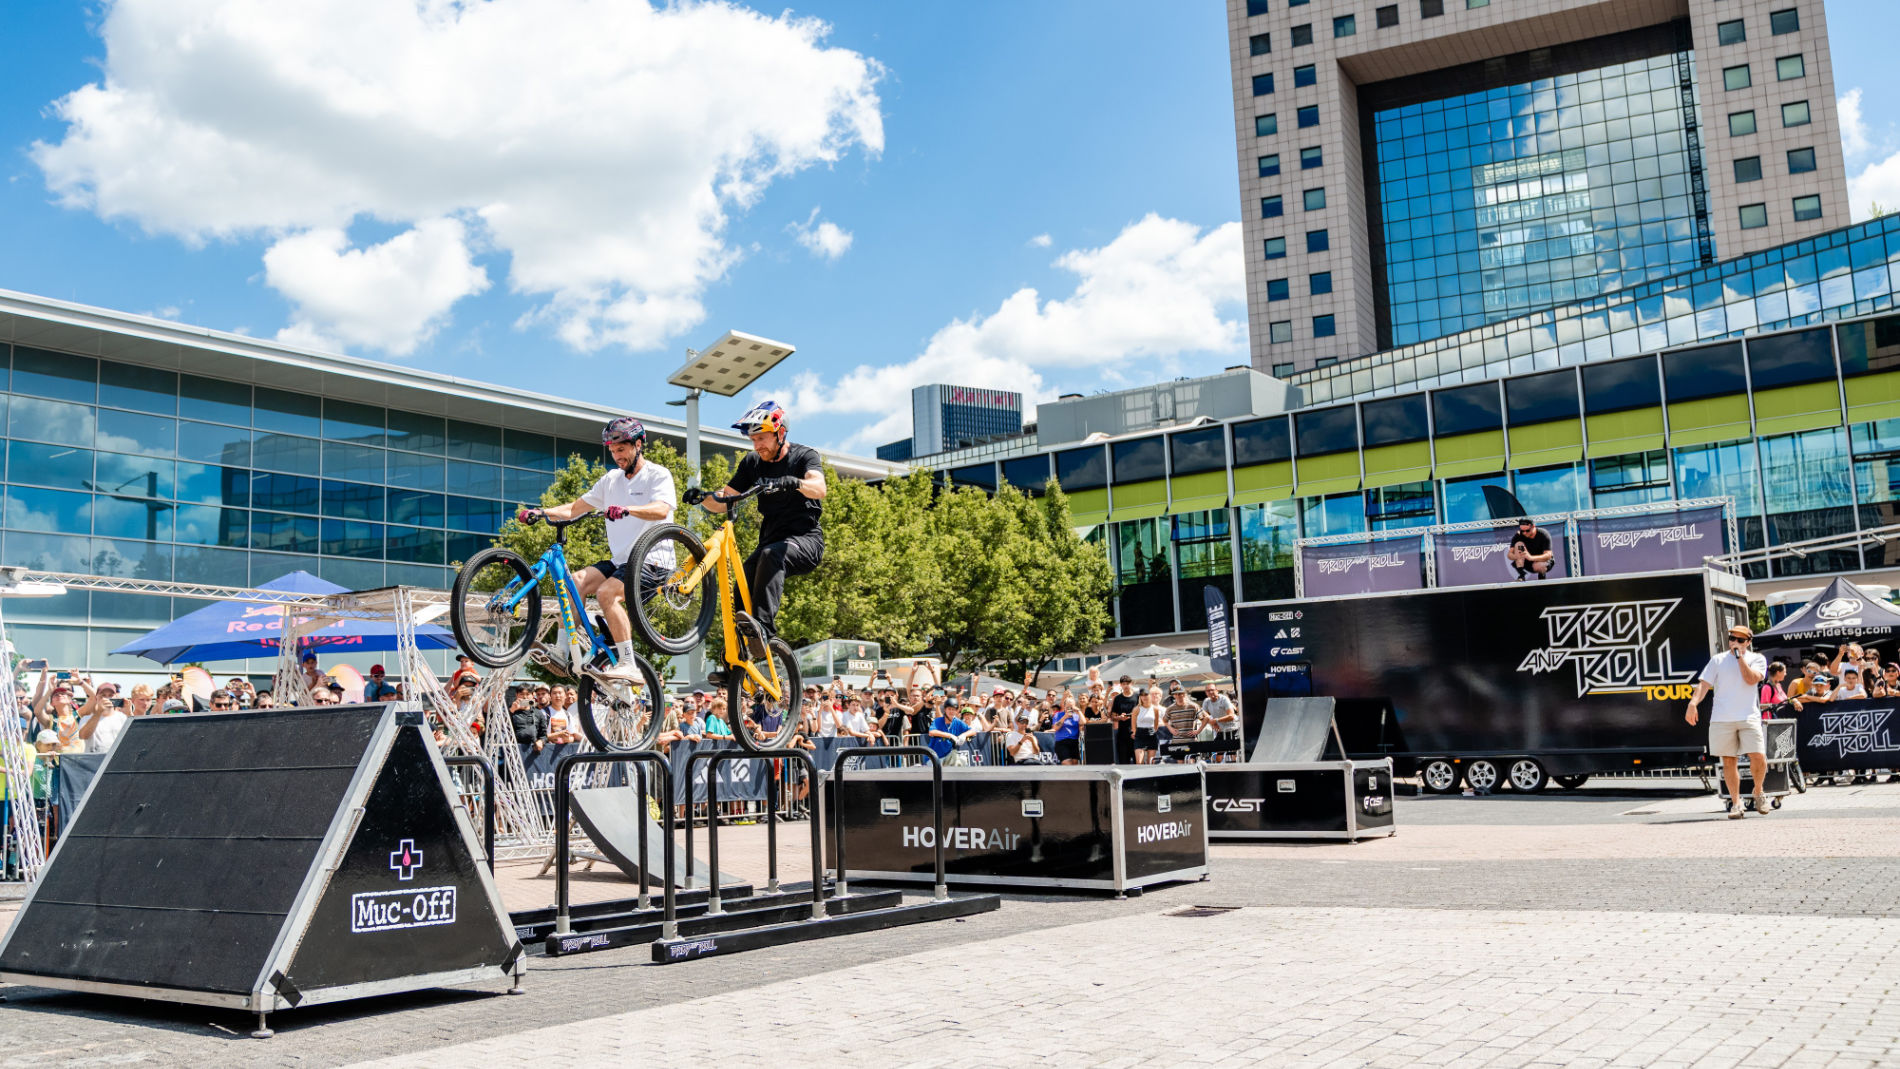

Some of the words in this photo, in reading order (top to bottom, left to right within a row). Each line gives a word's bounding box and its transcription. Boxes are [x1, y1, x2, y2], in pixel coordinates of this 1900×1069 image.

[1657, 523, 1704, 546] ROLL
[1366, 552, 1405, 571] ROLL
[557, 579, 579, 645] MARIN
[1539, 597, 1683, 649] DROP
[227, 617, 284, 633] Red
[1783, 626, 1891, 640] www.ridetsg.com
[1281, 647, 1304, 655] CAST
[1516, 648, 1571, 675] AND
[1566, 638, 1698, 699] ROLL
[1645, 685, 1693, 701] TOUR
[1819, 708, 1895, 734] DROP
[1807, 733, 1834, 747] AND
[1833, 729, 1900, 758] ROLL
[1212, 798, 1266, 812] CAST
[903, 826, 1021, 851] HOVERAir
[1137, 819, 1192, 844] HOVERAir
[357, 891, 452, 927] Muc-Off
